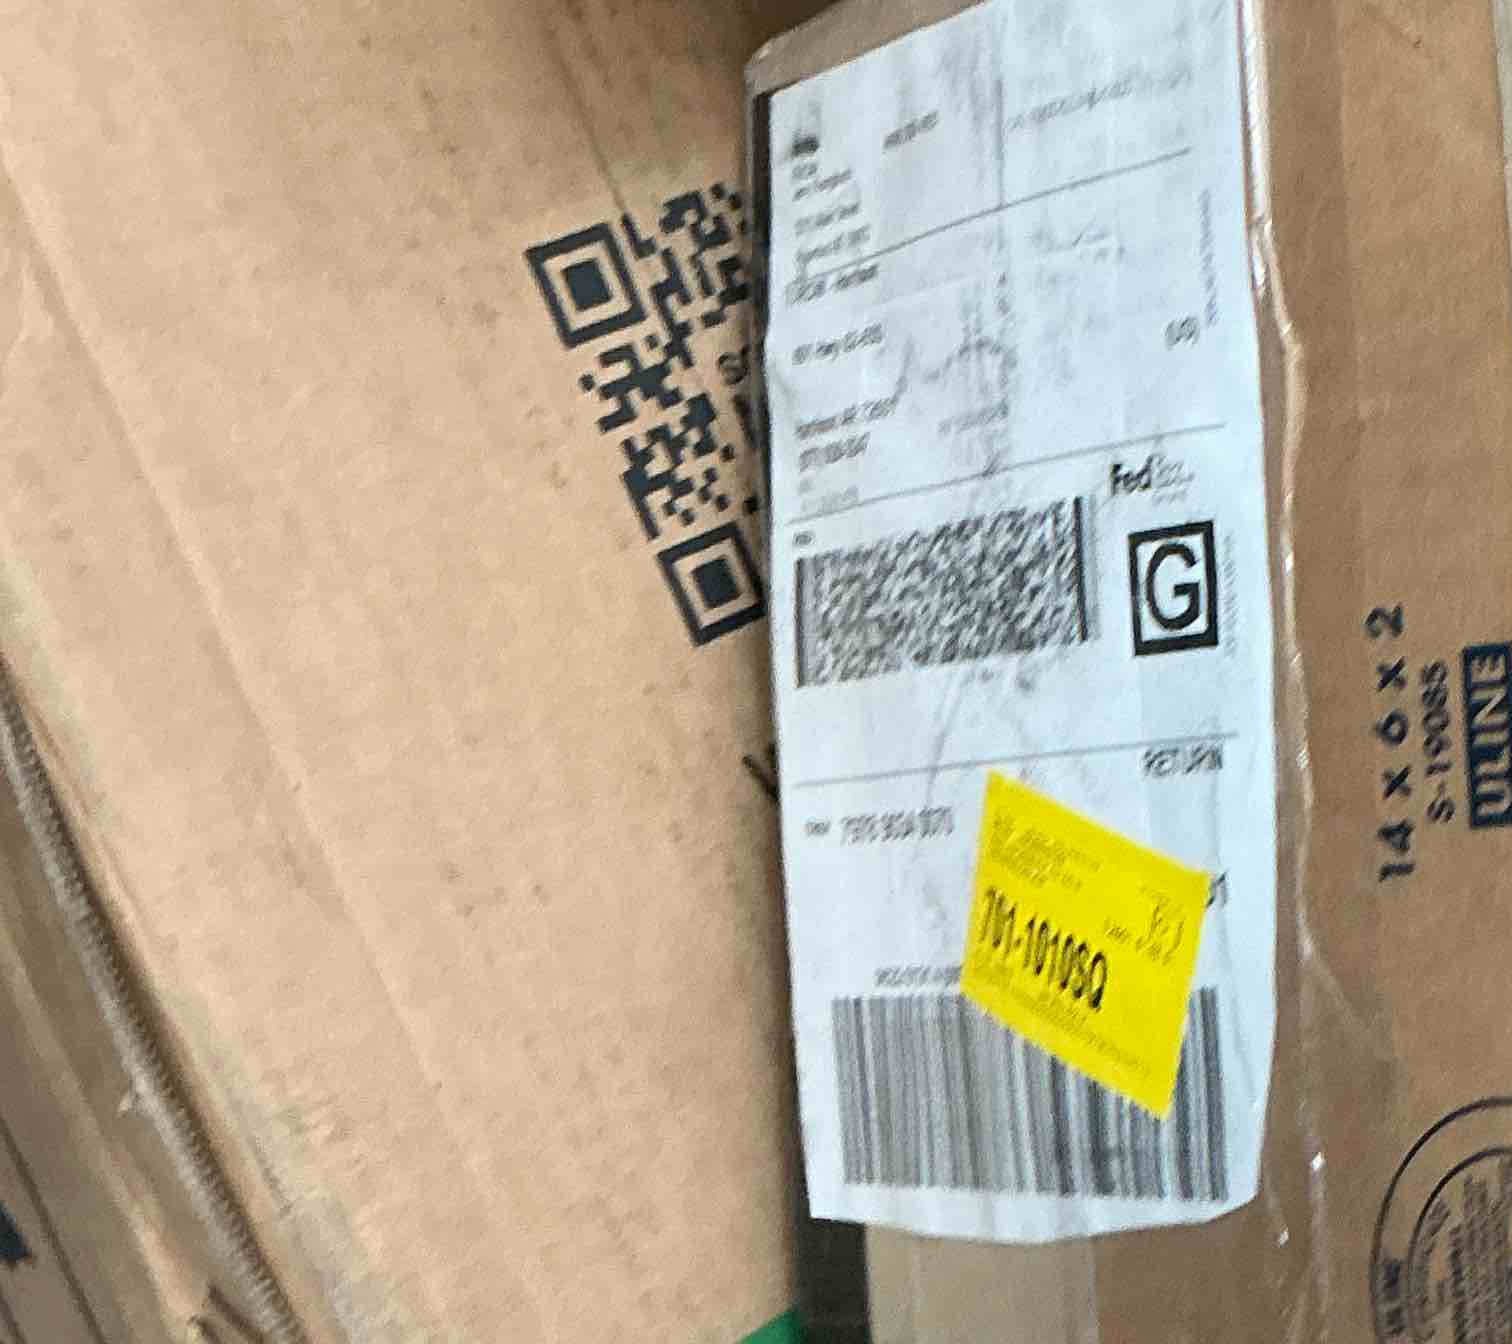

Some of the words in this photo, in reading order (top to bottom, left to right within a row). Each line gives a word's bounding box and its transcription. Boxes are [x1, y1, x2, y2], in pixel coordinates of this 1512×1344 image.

[1146, 542, 1201, 631] G
[1363, 602, 1405, 637] 2
[1373, 708, 1409, 748] 6
[1375, 817, 1416, 883] 14
